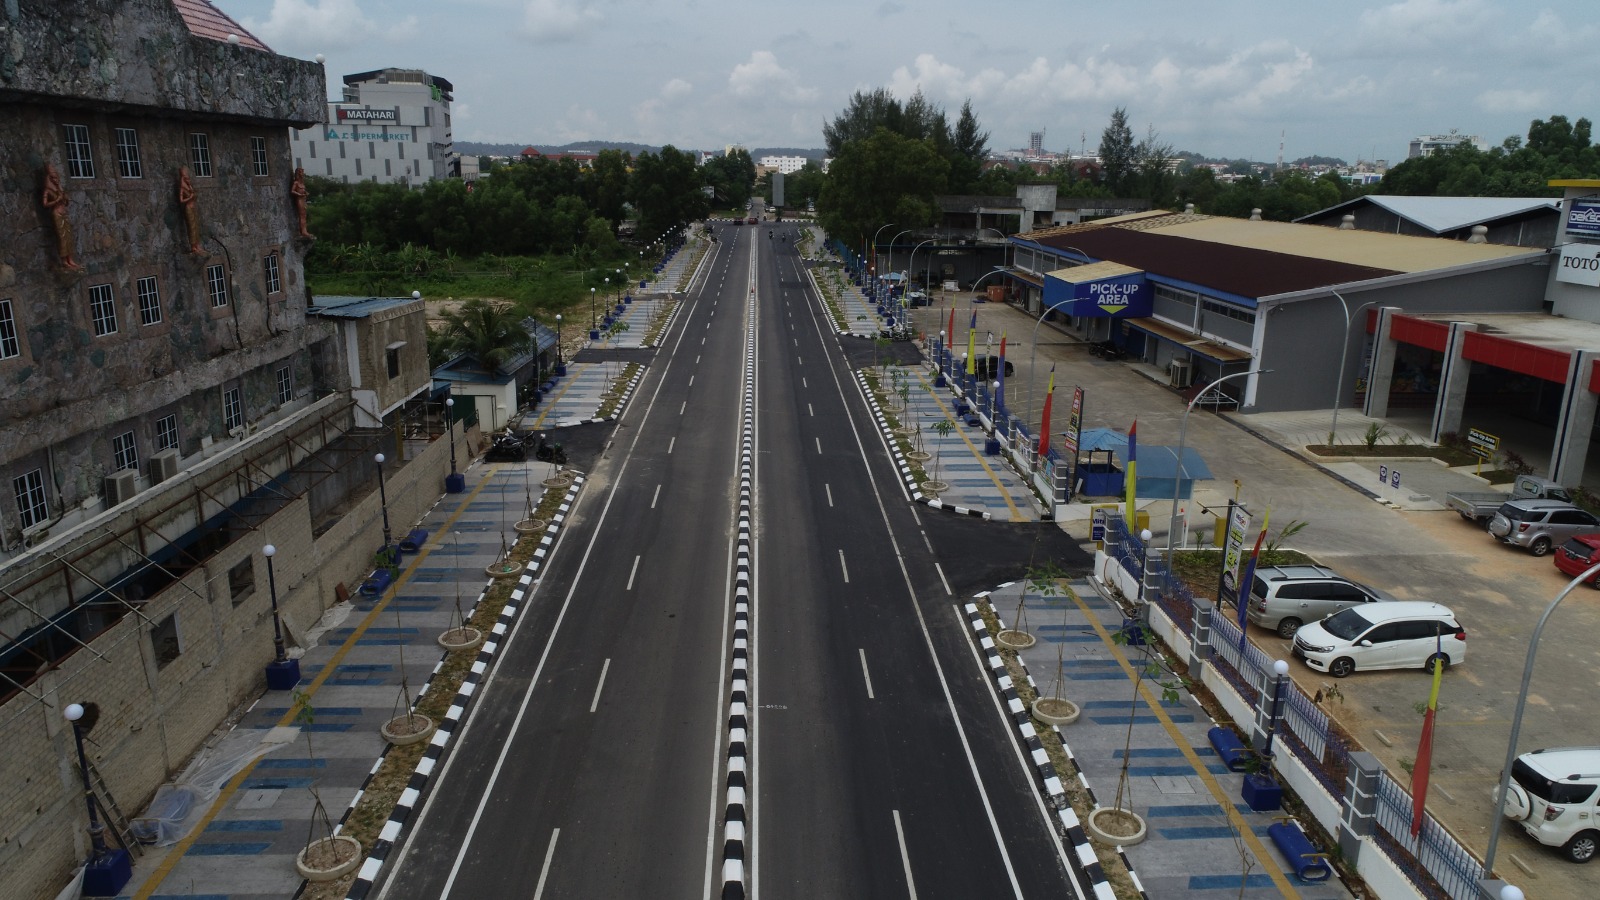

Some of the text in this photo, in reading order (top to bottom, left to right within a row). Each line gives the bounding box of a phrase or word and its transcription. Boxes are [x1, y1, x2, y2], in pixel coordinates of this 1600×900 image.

[347, 110, 395, 120] MATAHARI
[350, 133, 410, 141] SUPERMARKET
[1563, 256, 1599, 271] TOTO
[1090, 284, 1139, 294] PICK-UP
[1097, 295, 1129, 304] AREA
